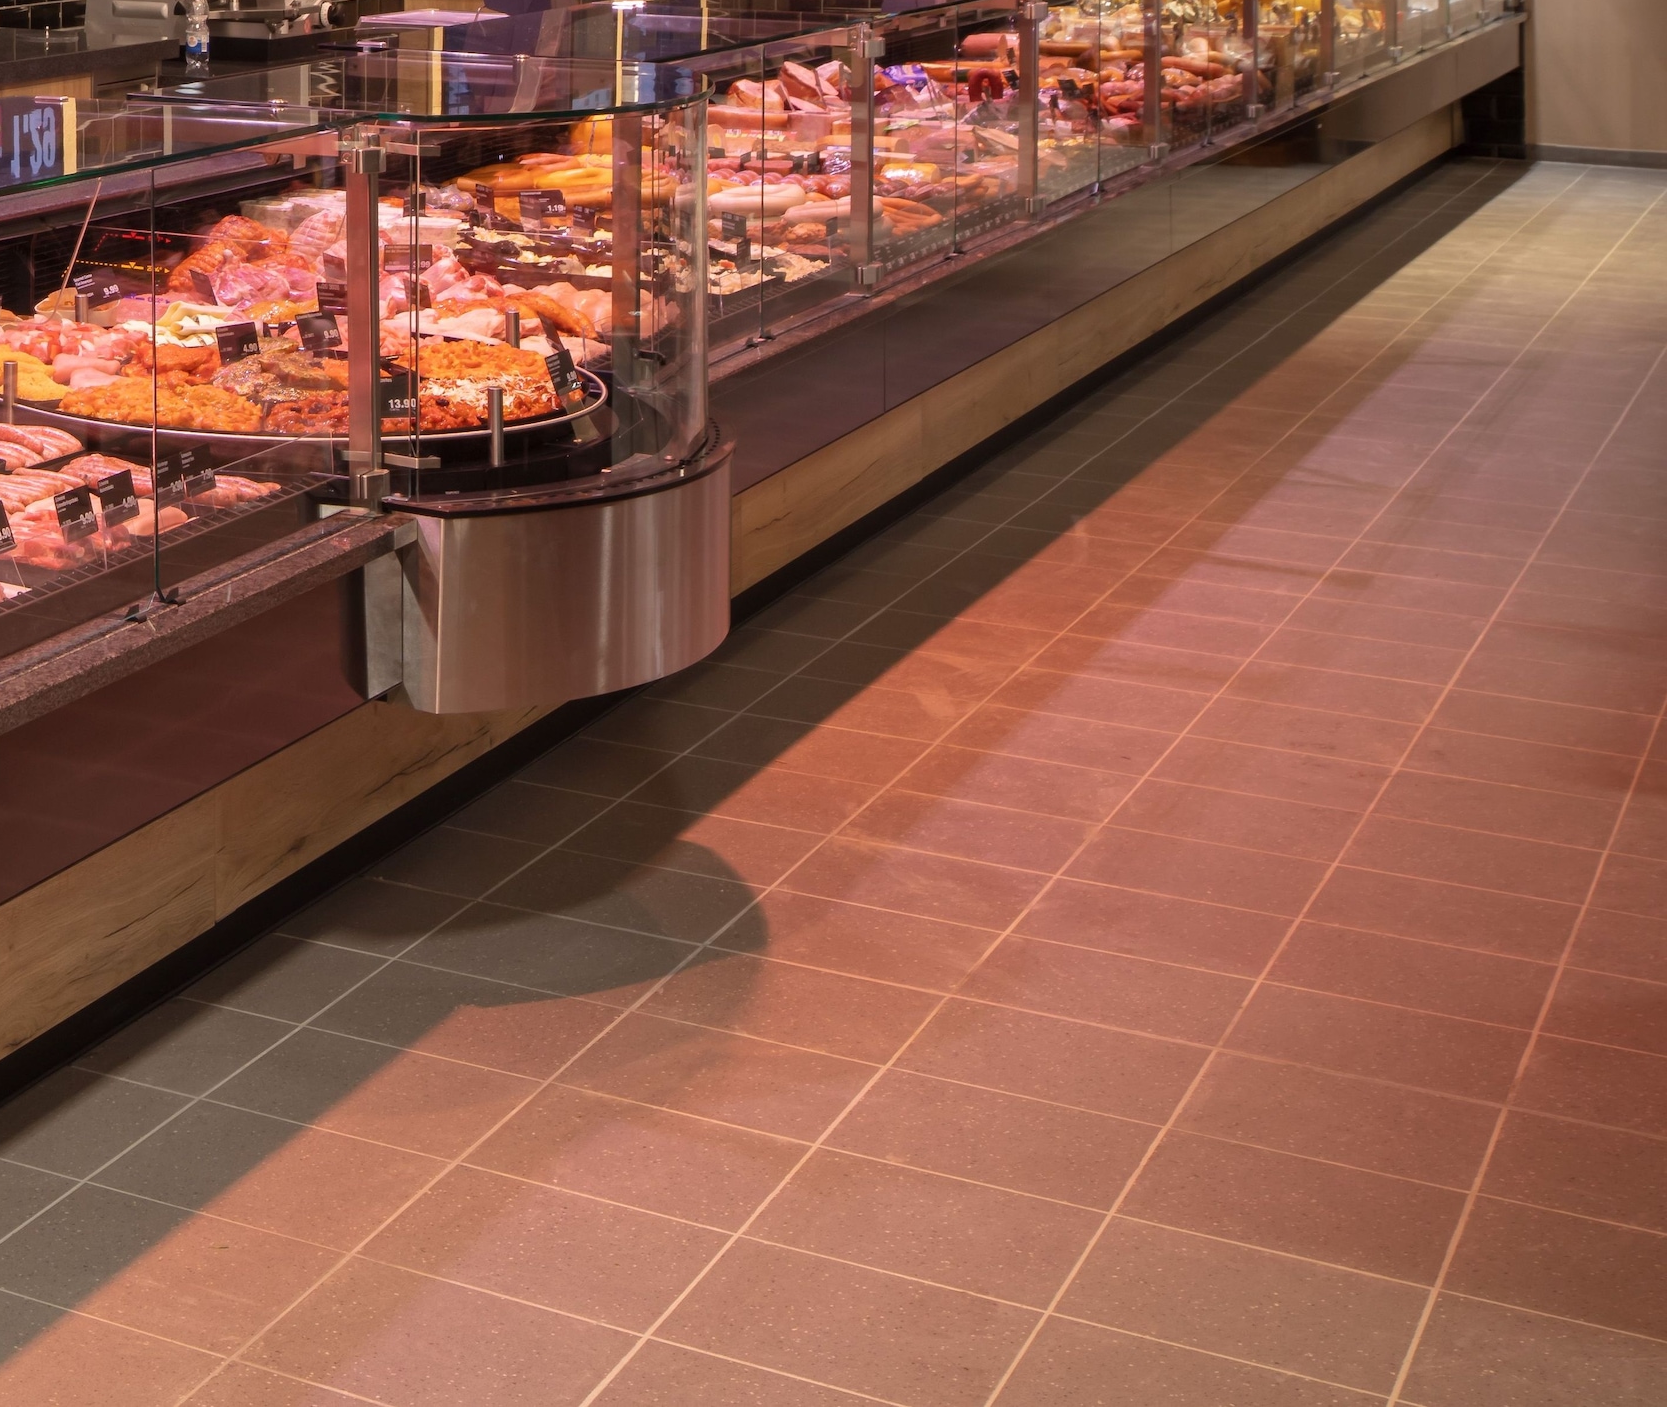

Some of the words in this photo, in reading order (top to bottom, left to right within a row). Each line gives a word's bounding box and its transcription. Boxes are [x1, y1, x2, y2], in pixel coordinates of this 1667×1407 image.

[103, 284, 119, 296] 9.99
[243, 342, 258, 353] 4.90
[388, 397, 417, 409] 13.90
